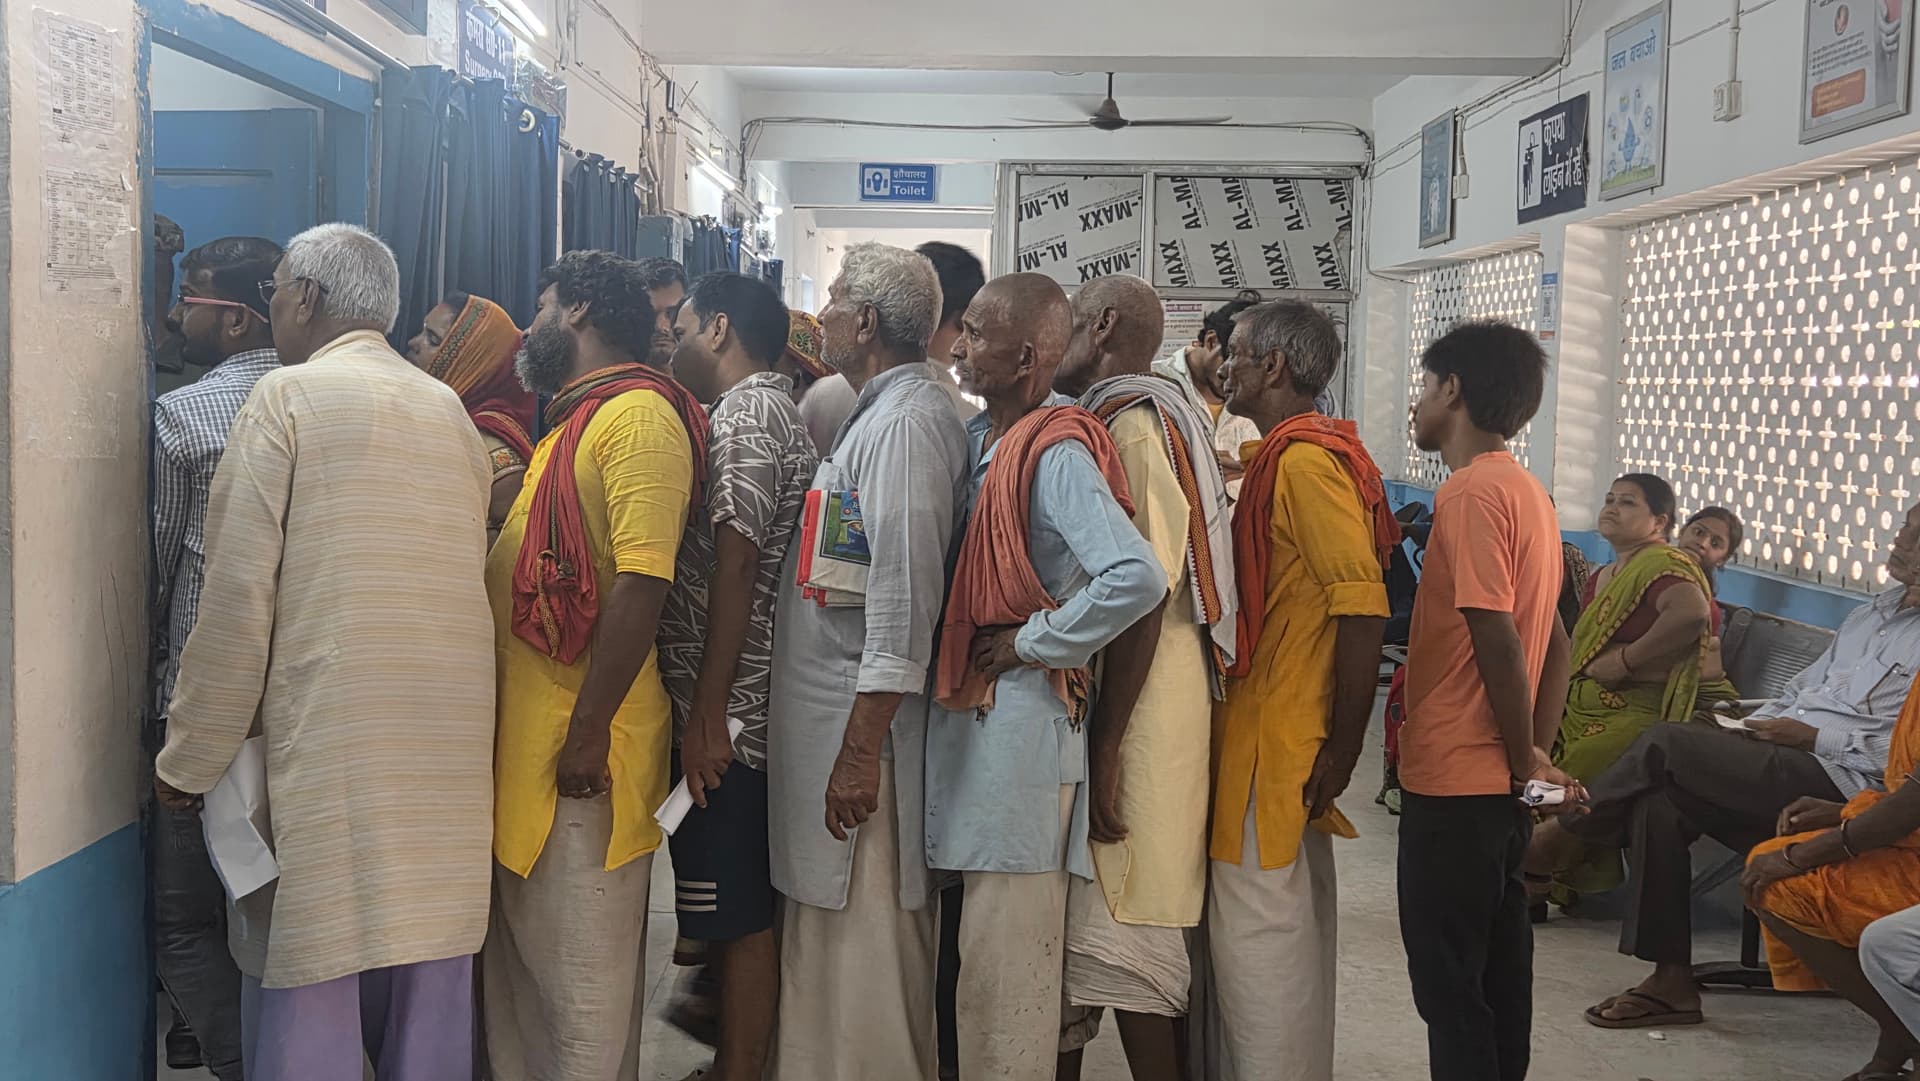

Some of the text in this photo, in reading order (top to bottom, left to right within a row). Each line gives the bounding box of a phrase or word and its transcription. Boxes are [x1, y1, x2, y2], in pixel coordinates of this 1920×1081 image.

[1611, 28, 1656, 71] जल बचाओ
[1543, 112, 1566, 155] कृपया
[893, 168, 927, 179] शौचालय
[892, 185, 927, 196] Toilet
